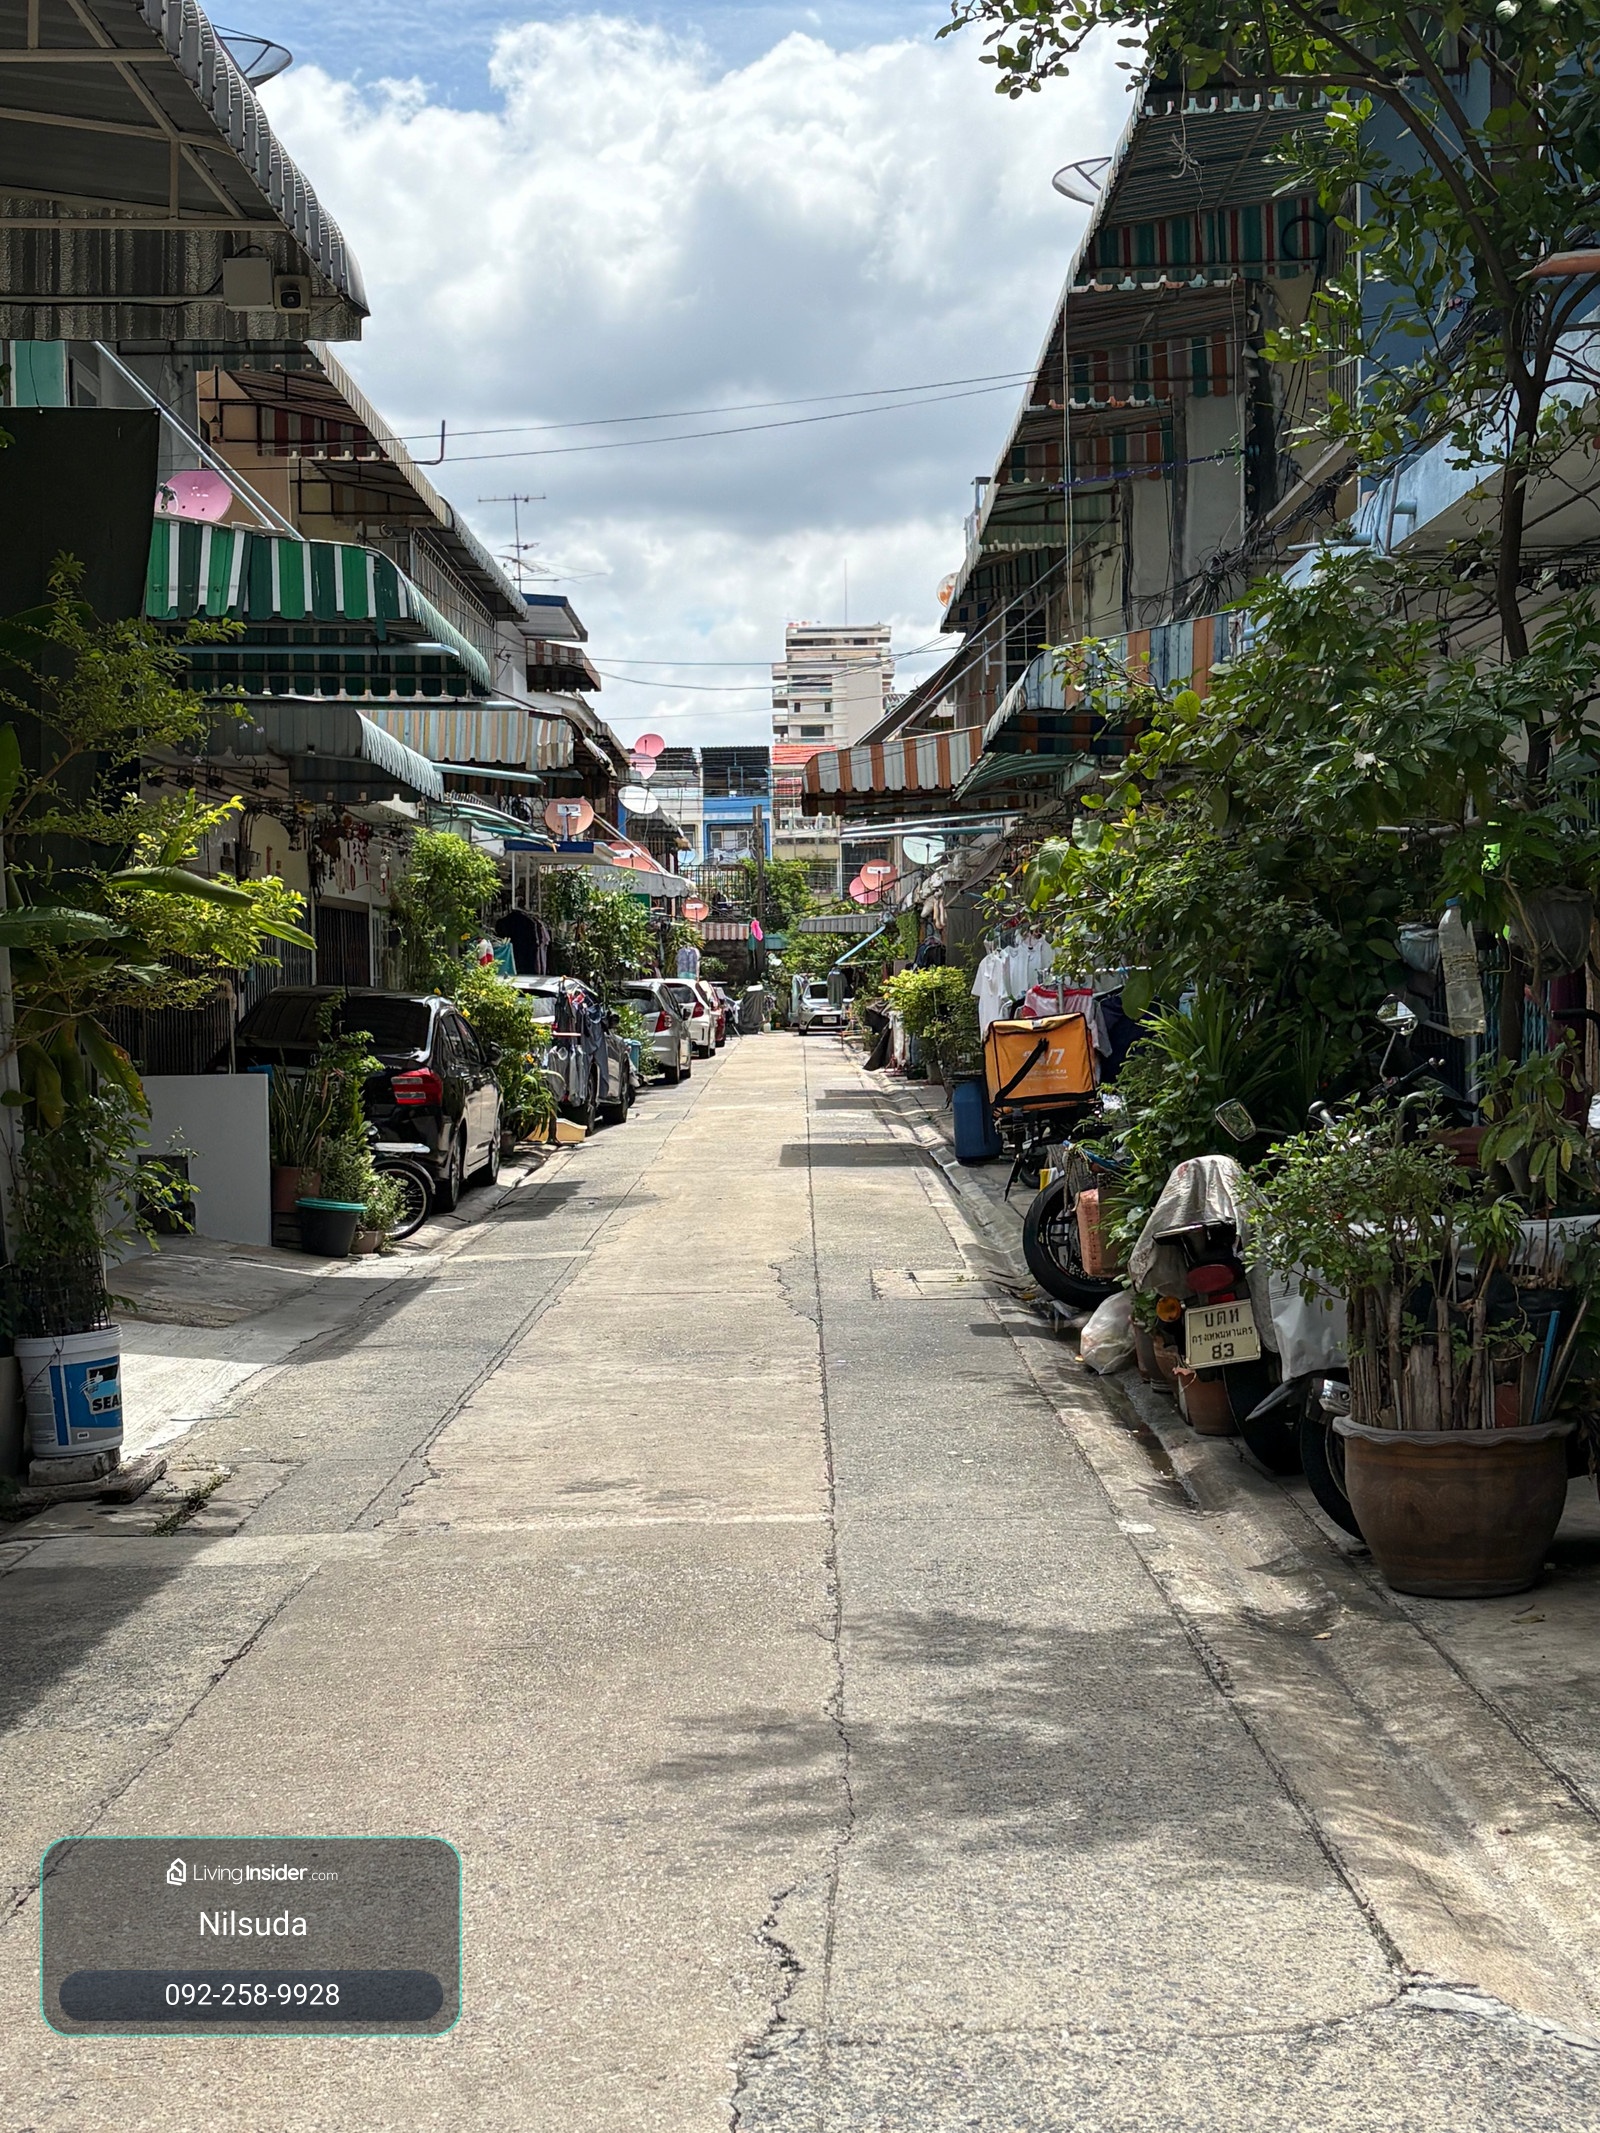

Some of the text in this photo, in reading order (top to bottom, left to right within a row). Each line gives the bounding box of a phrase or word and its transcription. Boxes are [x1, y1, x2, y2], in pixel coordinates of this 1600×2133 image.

[1192, 1326, 1253, 1345] กรุงเทพมหานคร
[1211, 1343, 1234, 1359] 83
